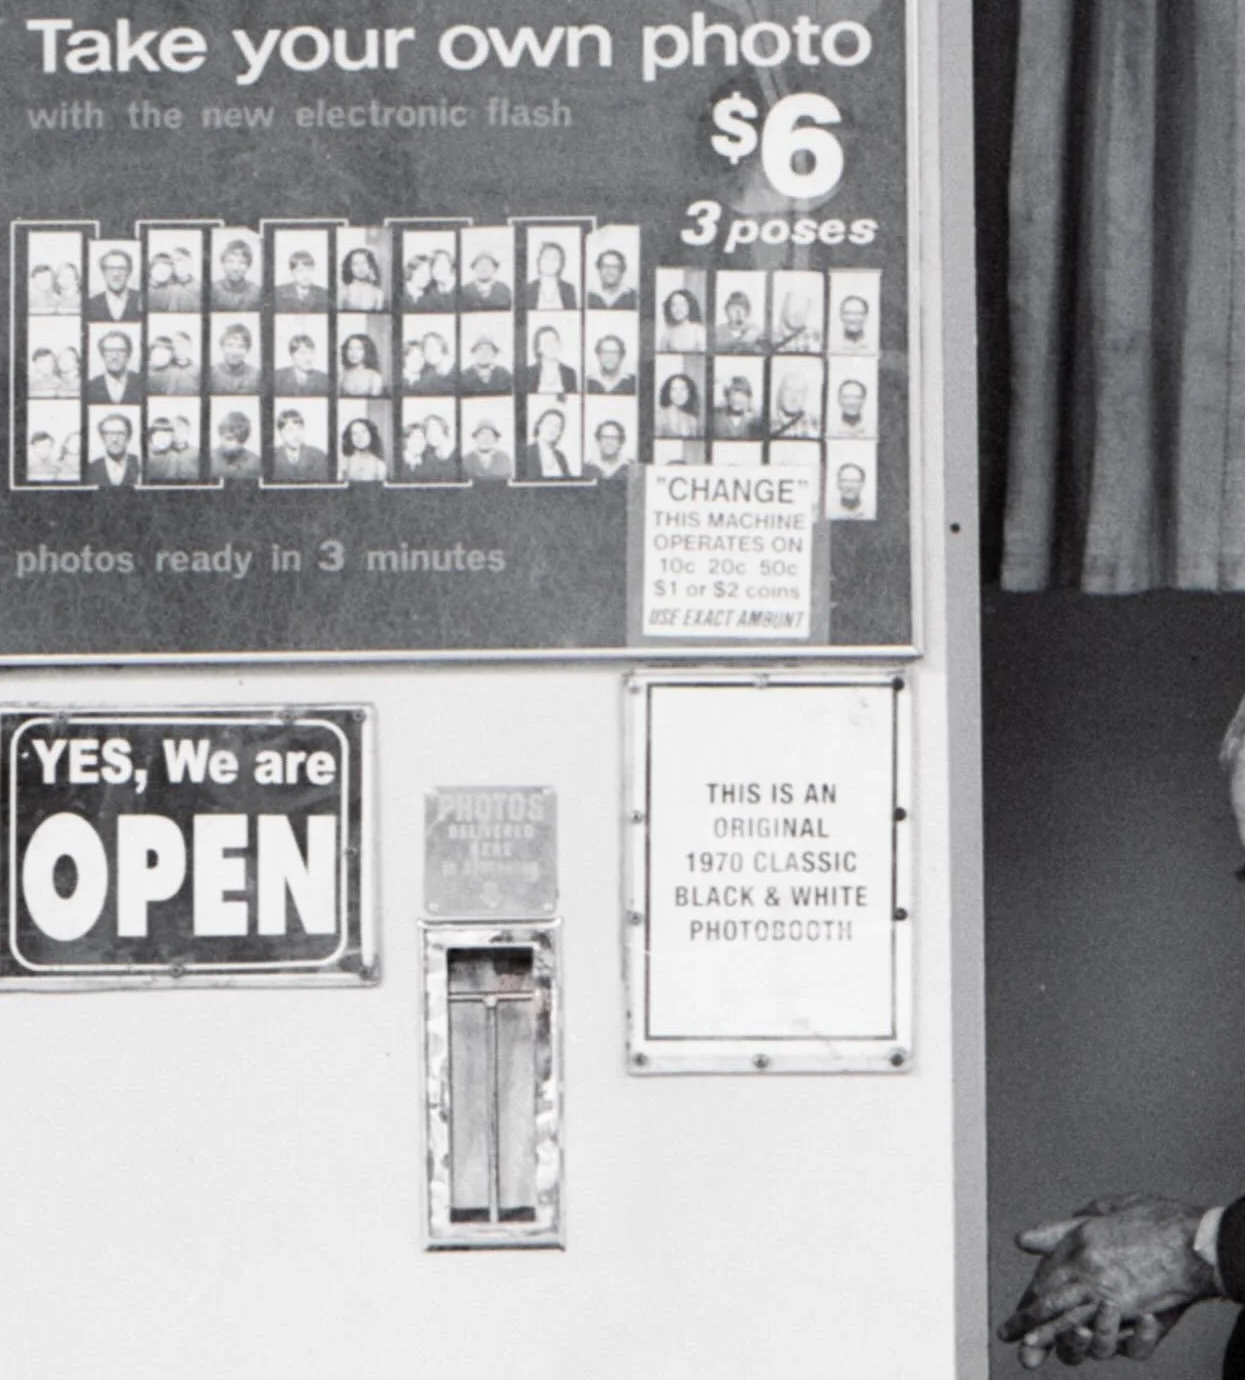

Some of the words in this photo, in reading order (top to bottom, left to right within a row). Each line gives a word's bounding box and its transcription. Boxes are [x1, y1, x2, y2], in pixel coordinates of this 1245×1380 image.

[26, 17, 208, 74] Take
[232, 24, 416, 86] your
[438, 23, 613, 71] own
[642, 10, 873, 82] photo
[26, 98, 105, 130] with
[128, 98, 182, 130] the
[203, 105, 275, 129] new
[298, 97, 468, 129] electronic
[486, 96, 572, 128] flash
[710, 90, 845, 199] $6
[680, 199, 723, 246] 3
[723, 215, 879, 254] poses
[656, 475, 809, 504] "CHANGE"
[653, 510, 701, 529] THIS
[707, 512, 808, 531] MACHINE
[652, 533, 765, 553] OPERATES
[770, 536, 804, 554] ON
[15, 543, 135, 579] photos
[155, 542, 253, 579] ready
[271, 543, 302, 573] in
[317, 539, 346, 572] 3
[367, 542, 507, 573] minutes
[660, 557, 697, 575] 10c
[708, 558, 748, 576] 20c
[759, 559, 800, 577] 50c
[653, 579, 679, 598] $1
[685, 582, 707, 598] or
[712, 579, 740, 599] $2
[745, 583, 802, 601] coins
[648, 607, 680, 627] USE
[683, 608, 736, 628] EXACT
[735, 610, 806, 630] AMOUNT
[31, 738, 149, 795] YES,
[162, 738, 240, 785] We
[253, 748, 337, 785] are
[706, 782, 761, 805] THIS
[771, 782, 794, 805] IS
[804, 782, 837, 805] AN
[437, 792, 545, 821] PHOTOS
[713, 816, 830, 839] ORIGINAL
[686, 851, 744, 873] 1970
[753, 850, 857, 873] CLASSIC
[22, 811, 338, 942] OPEN
[674, 885, 755, 908] BLACK
[763, 885, 781, 908] &
[791, 885, 868, 908] WHITE
[689, 918, 853, 942] PHOTOBOOTH
